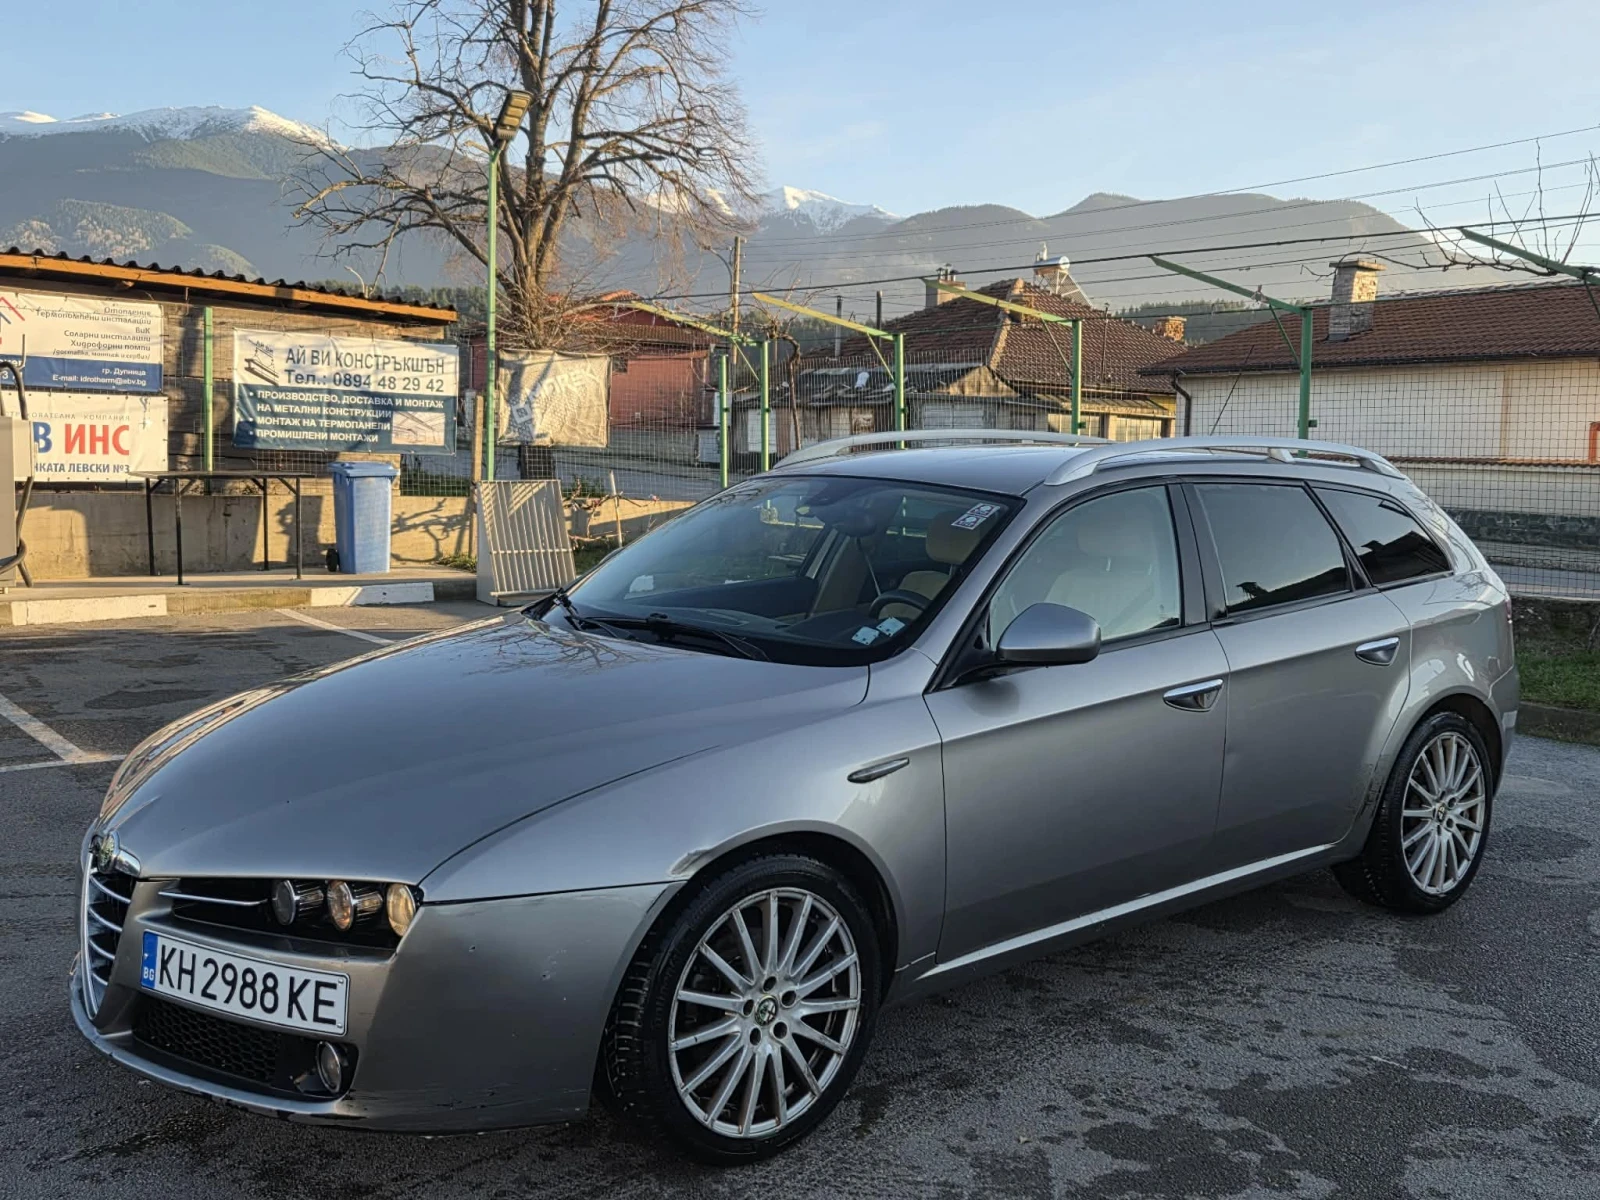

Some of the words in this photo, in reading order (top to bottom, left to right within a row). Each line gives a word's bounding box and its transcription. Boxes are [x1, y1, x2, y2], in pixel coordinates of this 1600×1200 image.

[101, 316, 151, 325] инсталации
[64, 329, 99, 340] Соларни
[100, 333, 151, 342] инсталации
[135, 326, 151, 335] ВиК
[71, 339, 122, 351] Хидрофорни
[124, 343, 151, 351] помпи
[285, 345, 306, 365] АЙ
[311, 350, 331, 366] ВИ
[335, 350, 445, 375] КОНСТРЪКШЪН
[52, 374, 79, 382] E-mail:
[102, 367, 113, 376] гр.
[113, 367, 147, 377] Дупница
[284, 369, 328, 386] Тел.:
[332, 371, 371, 388] 0894
[377, 375, 397, 390] 48
[402, 376, 421, 391] 29
[425, 378, 444, 393] 42
[257, 389, 341, 404] ПРОИЗВОДСТВО,
[341, 395, 394, 406] ДОСТАВКА
[395, 398, 402, 406] И
[404, 398, 444, 409] МОНТАЖ
[256, 403, 272, 412] НА
[273, 404, 321, 415] МЕТАЛНИ
[322, 406, 392, 418] КОНСТРУКЦИИ
[83, 414, 130, 422] КОМПАНИЯ
[256, 416, 300, 427] МОНТАЖ
[302, 417, 317, 427] НА
[319, 419, 391, 431] ТЕРМОПАНЕЛИ
[64, 423, 130, 456] ИНС
[256, 429, 328, 441] ПРОМИШЛЕНИ
[329, 431, 379, 443] МОНТАЖИ
[68, 463, 110, 474] ЛЕВСКИ
[113, 464, 130, 475] №3
[142, 966, 155, 982] BG
